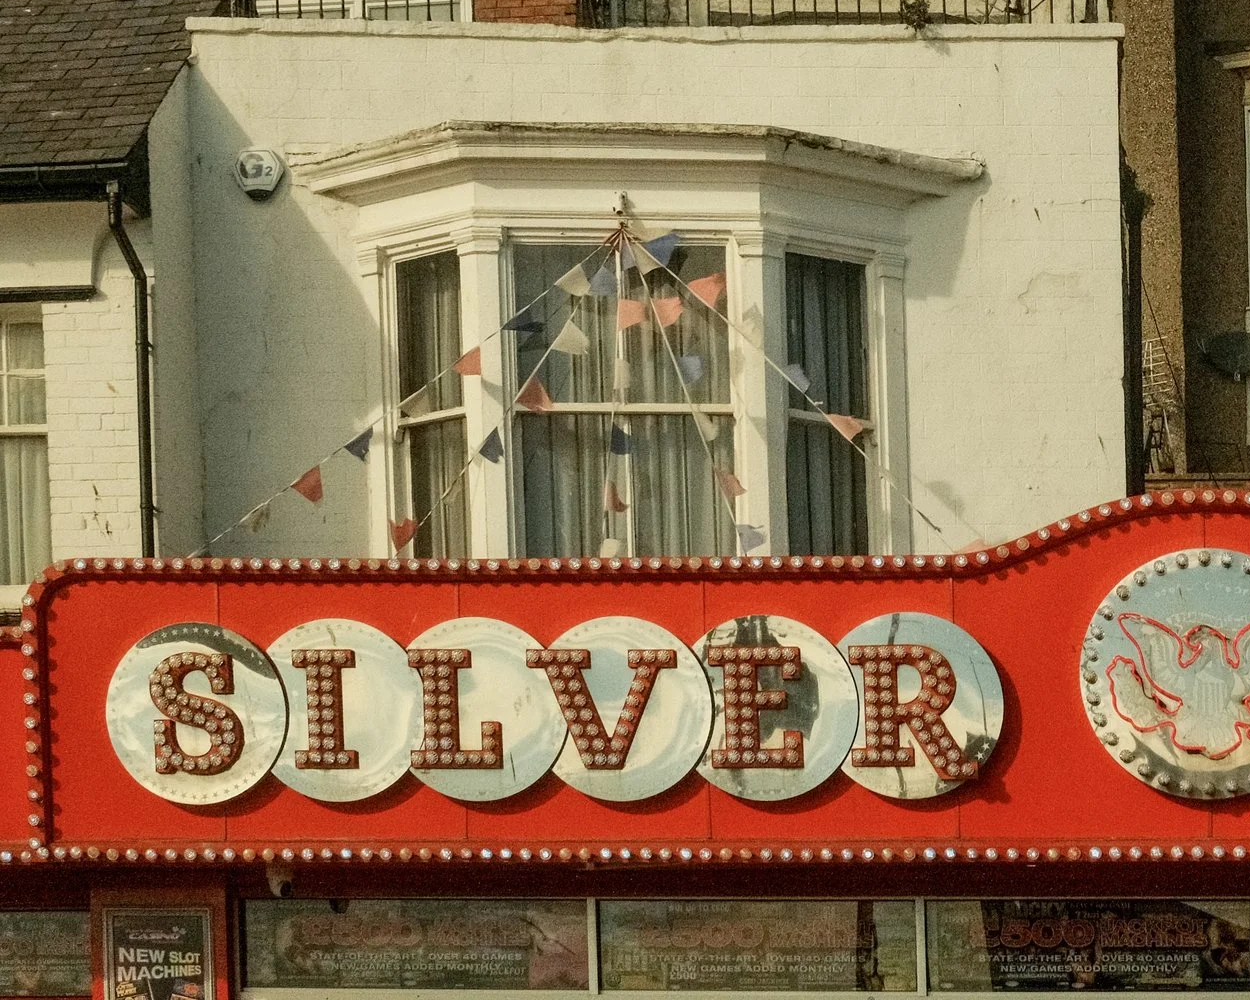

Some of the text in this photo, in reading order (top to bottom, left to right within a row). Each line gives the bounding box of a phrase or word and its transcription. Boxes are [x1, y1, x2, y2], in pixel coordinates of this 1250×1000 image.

[240, 153, 273, 179] G2
[149, 643, 979, 780] SILVER
[971, 919, 1096, 948] £500
[1100, 933, 1209, 948] MACHINES
[118, 947, 200, 963] NEW SLOT
[770, 954, 803, 962] OVER
[807, 954, 821, 962] 40
[825, 954, 866, 962] GAMES
[1101, 954, 1134, 962] OVER
[1137, 954, 1153, 962] 40
[1156, 954, 1200, 962] GAMES
[331, 962, 502, 970] NEW GAMES ADDED MONTHLY
[671, 964, 845, 972] NEW GAMES ADDED MONTHLY
[1000, 964, 1178, 972] NEW GAMES ADDED MONTHLY
[116, 965, 202, 982] MACHINES
[669, 972, 697, 980] £500
